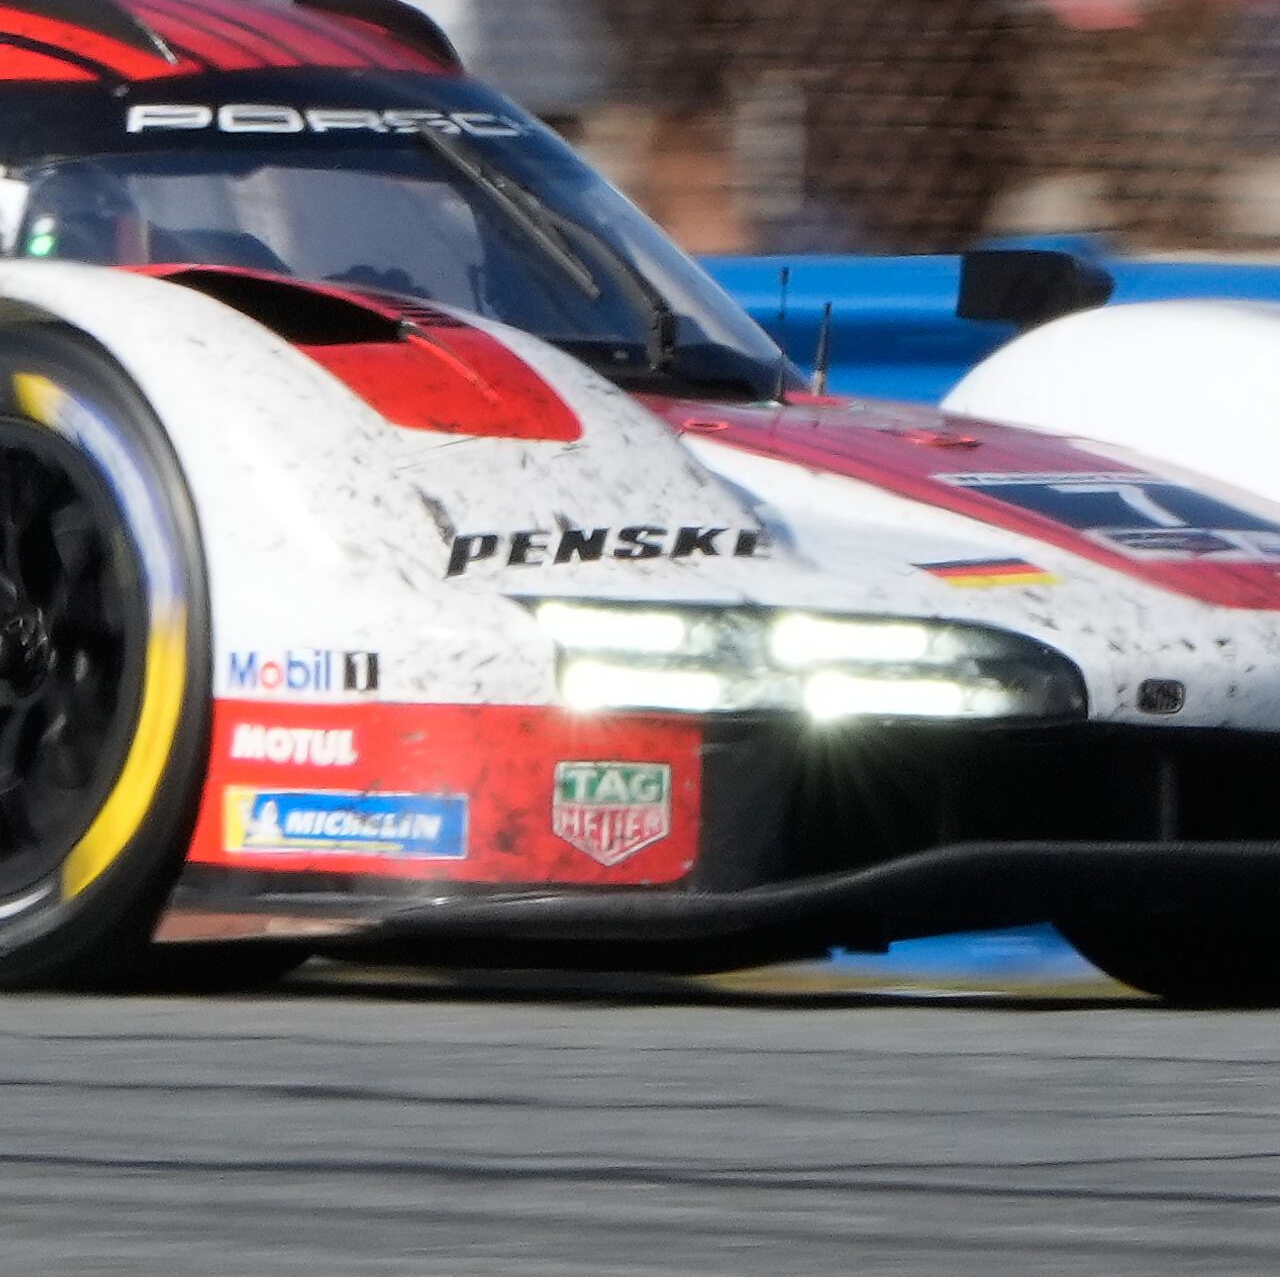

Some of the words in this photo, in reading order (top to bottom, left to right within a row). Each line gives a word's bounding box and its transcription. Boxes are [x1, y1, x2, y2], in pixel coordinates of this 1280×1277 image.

[443, 525, 776, 579] PENSKE
[228, 650, 331, 692] Mobil
[230, 724, 359, 766] MOTUL
[565, 767, 662, 804] TAG
[283, 809, 441, 840] MICHELIN
[560, 810, 664, 857] HEUER
